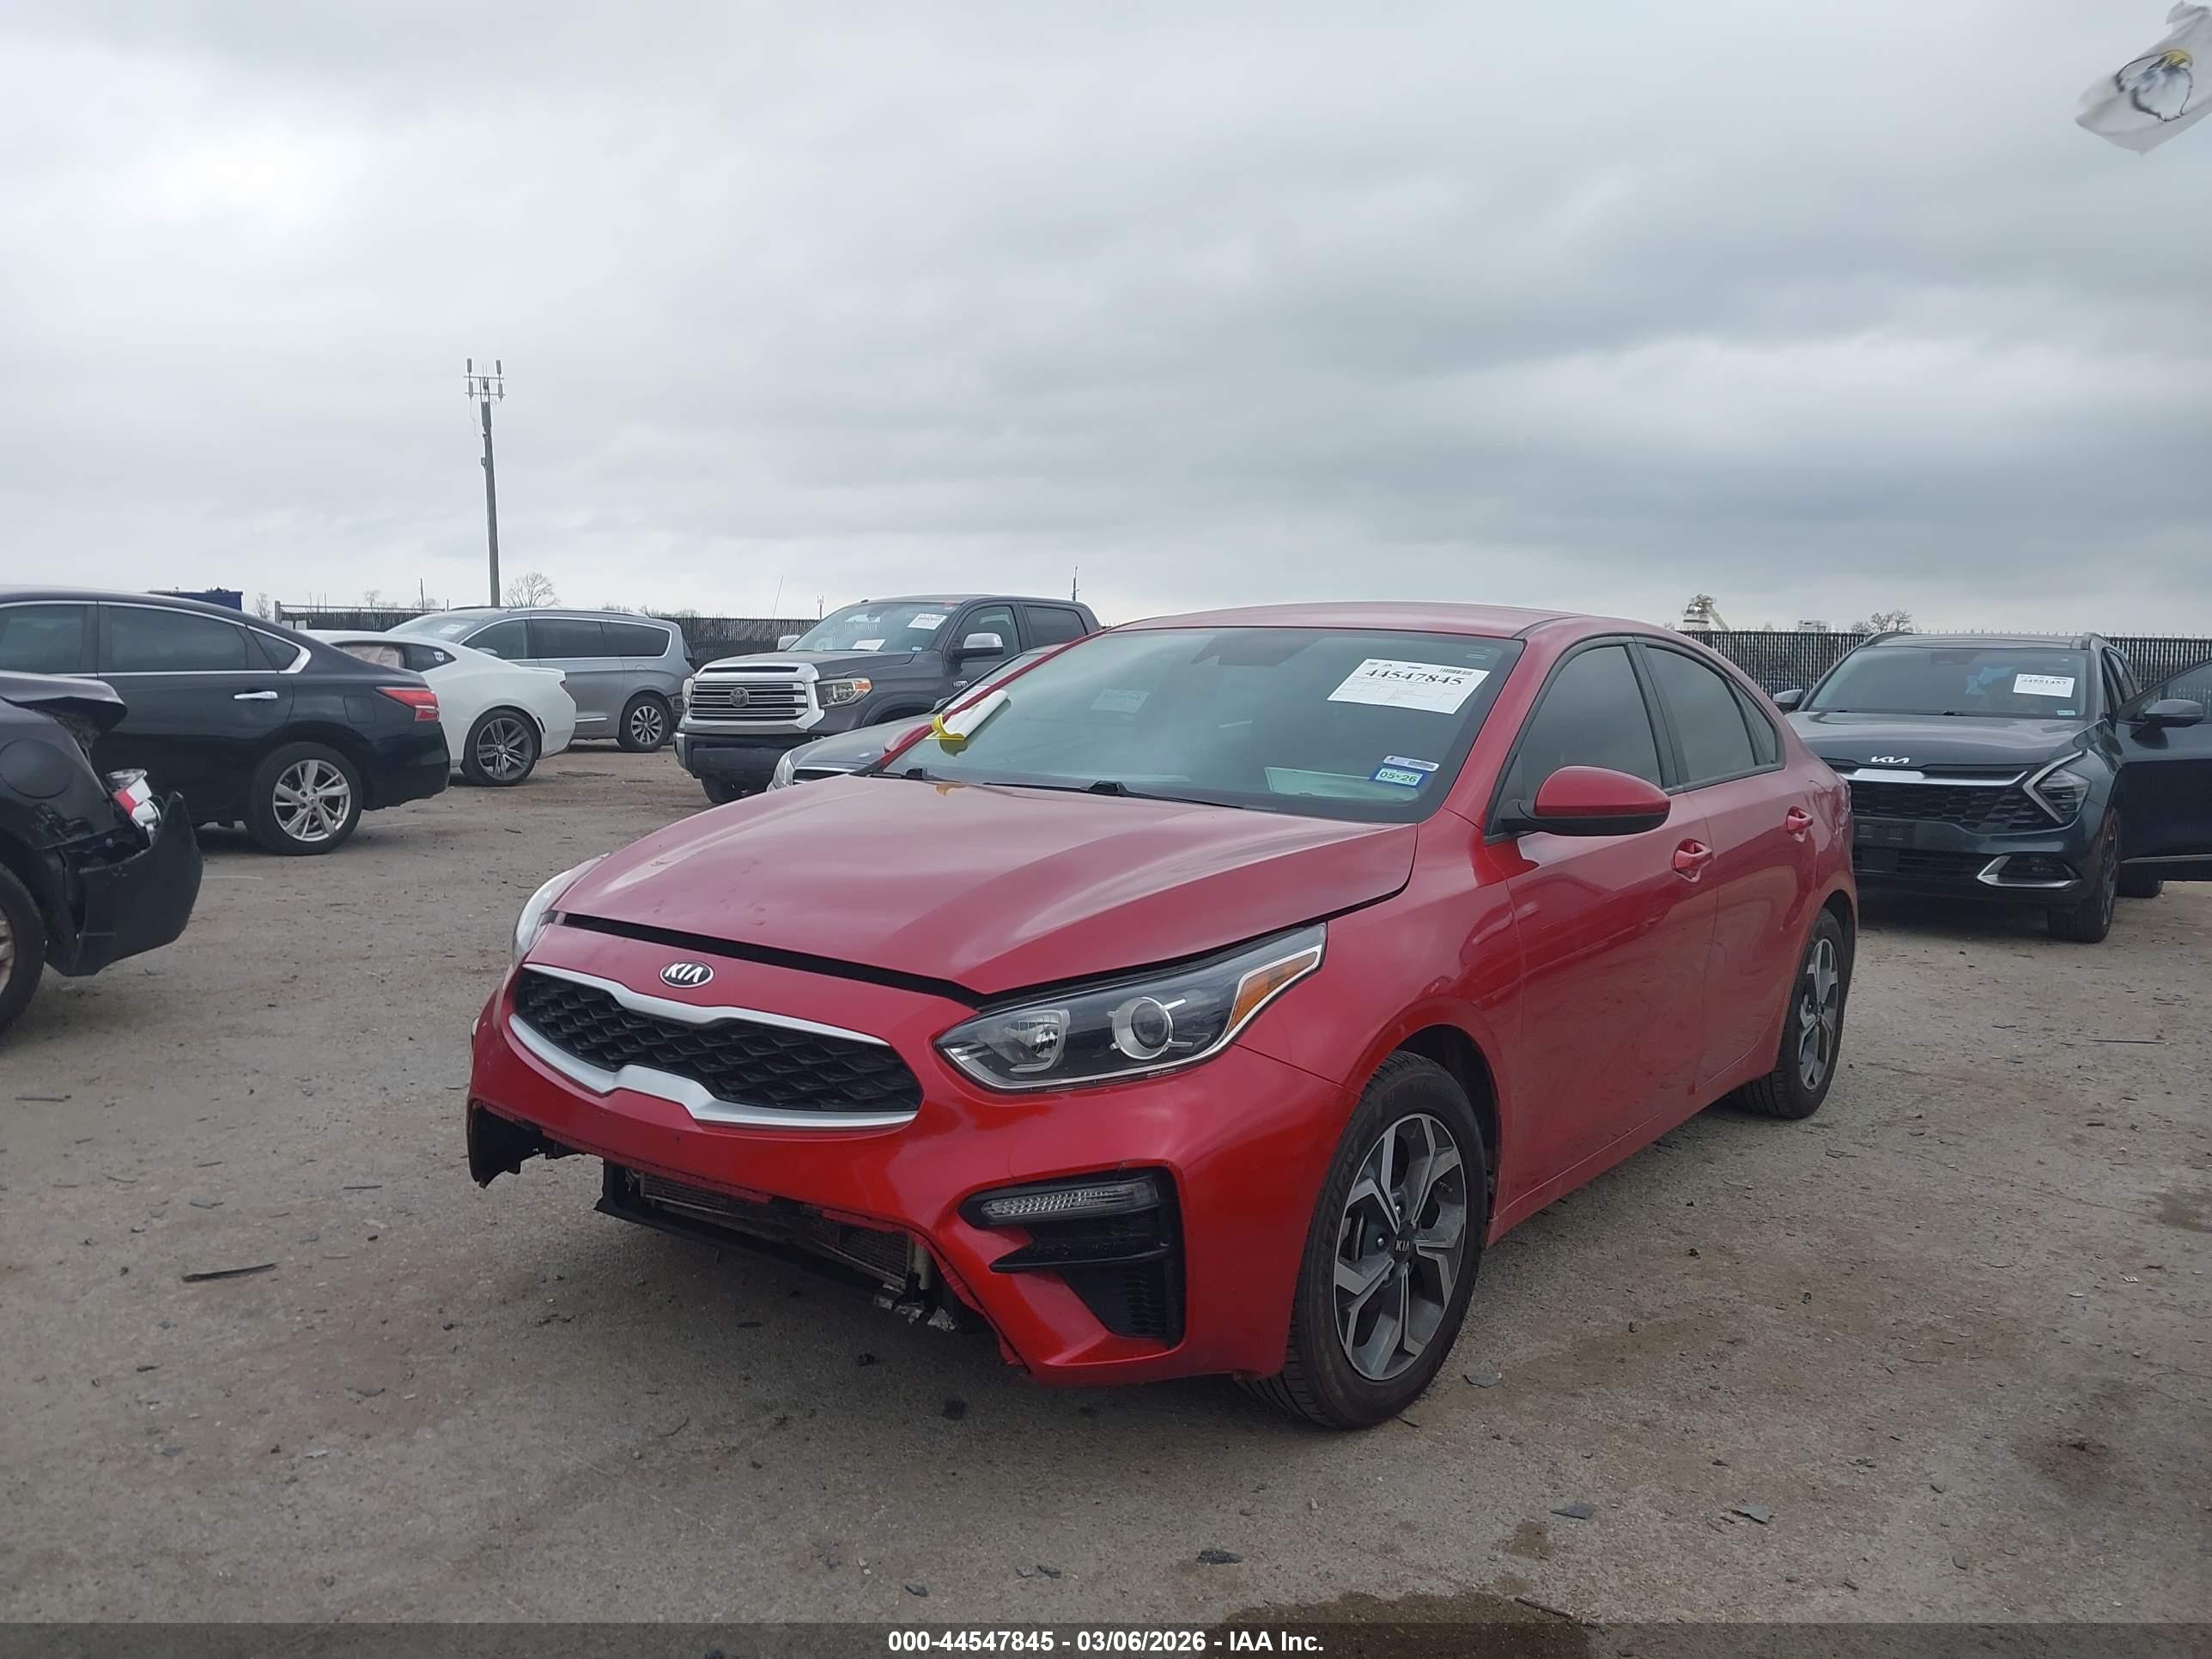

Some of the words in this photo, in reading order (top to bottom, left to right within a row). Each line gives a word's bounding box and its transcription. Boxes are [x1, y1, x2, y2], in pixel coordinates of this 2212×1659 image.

[1364, 668, 1466, 686] 44547845
[1870, 756, 1911, 764] KIA
[664, 963, 704, 983] KIA
[1395, 1239, 1410, 1251] KIA
